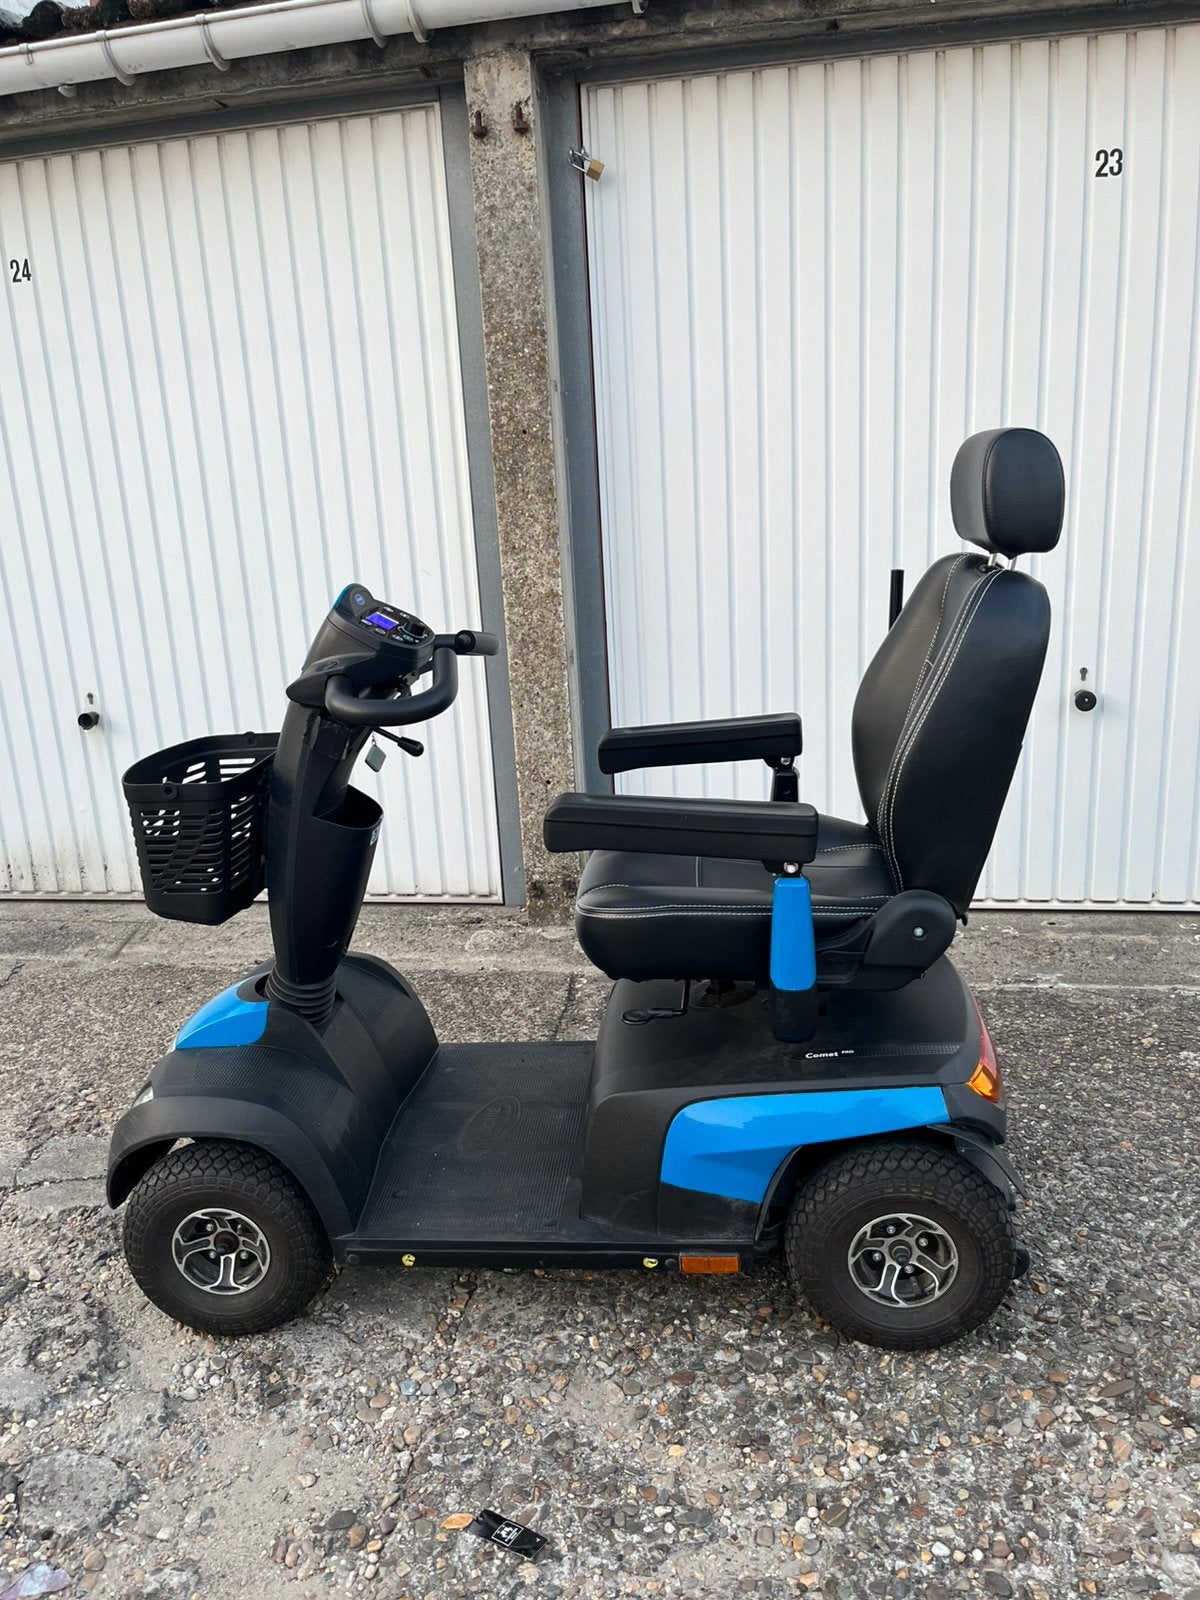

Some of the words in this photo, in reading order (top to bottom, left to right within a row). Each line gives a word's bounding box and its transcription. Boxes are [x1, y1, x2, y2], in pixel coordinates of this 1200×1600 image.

[1095, 148, 1123, 178] 23
[10, 258, 32, 283] 24
[805, 1051, 839, 1059] Comet
